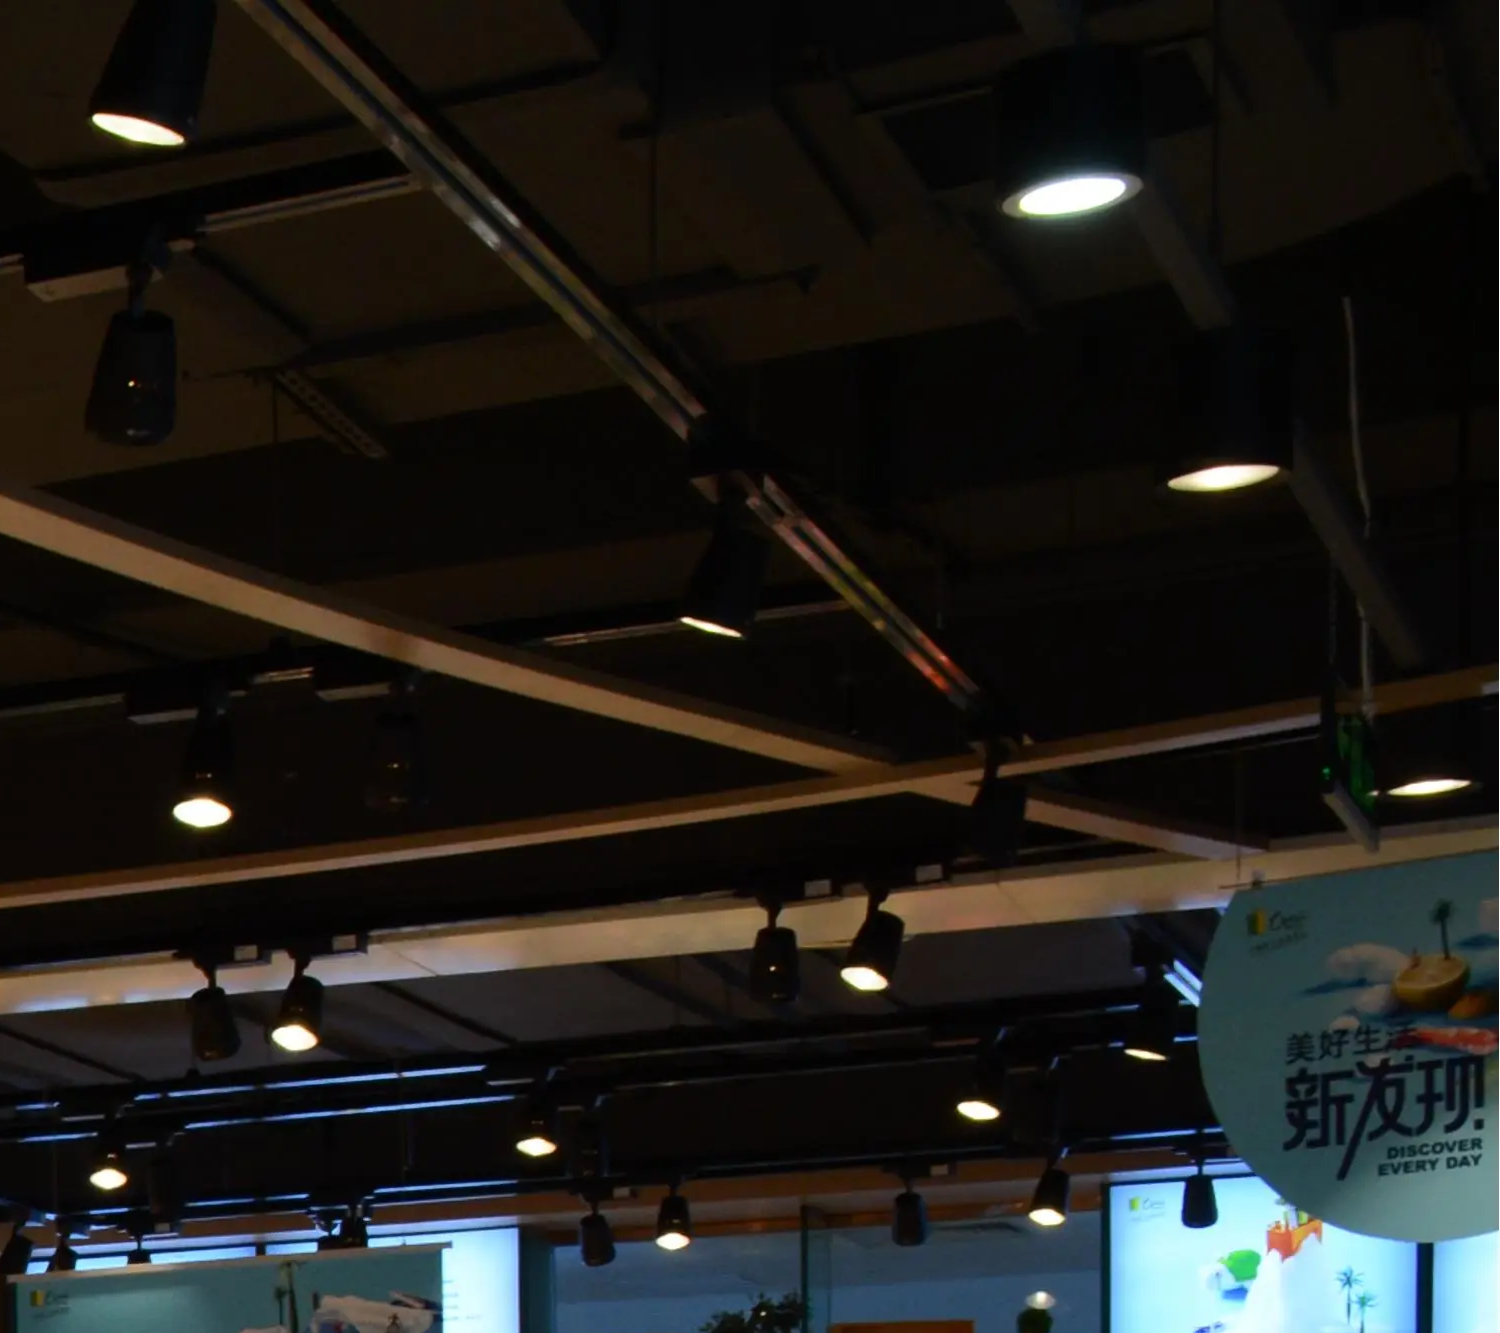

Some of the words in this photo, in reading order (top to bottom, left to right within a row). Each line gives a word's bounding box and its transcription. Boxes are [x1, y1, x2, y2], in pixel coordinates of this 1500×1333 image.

[1386, 1137, 1484, 1160] DISCOVER
[1377, 1157, 1440, 1177] EVERY
[1445, 1153, 1484, 1170] DAY
